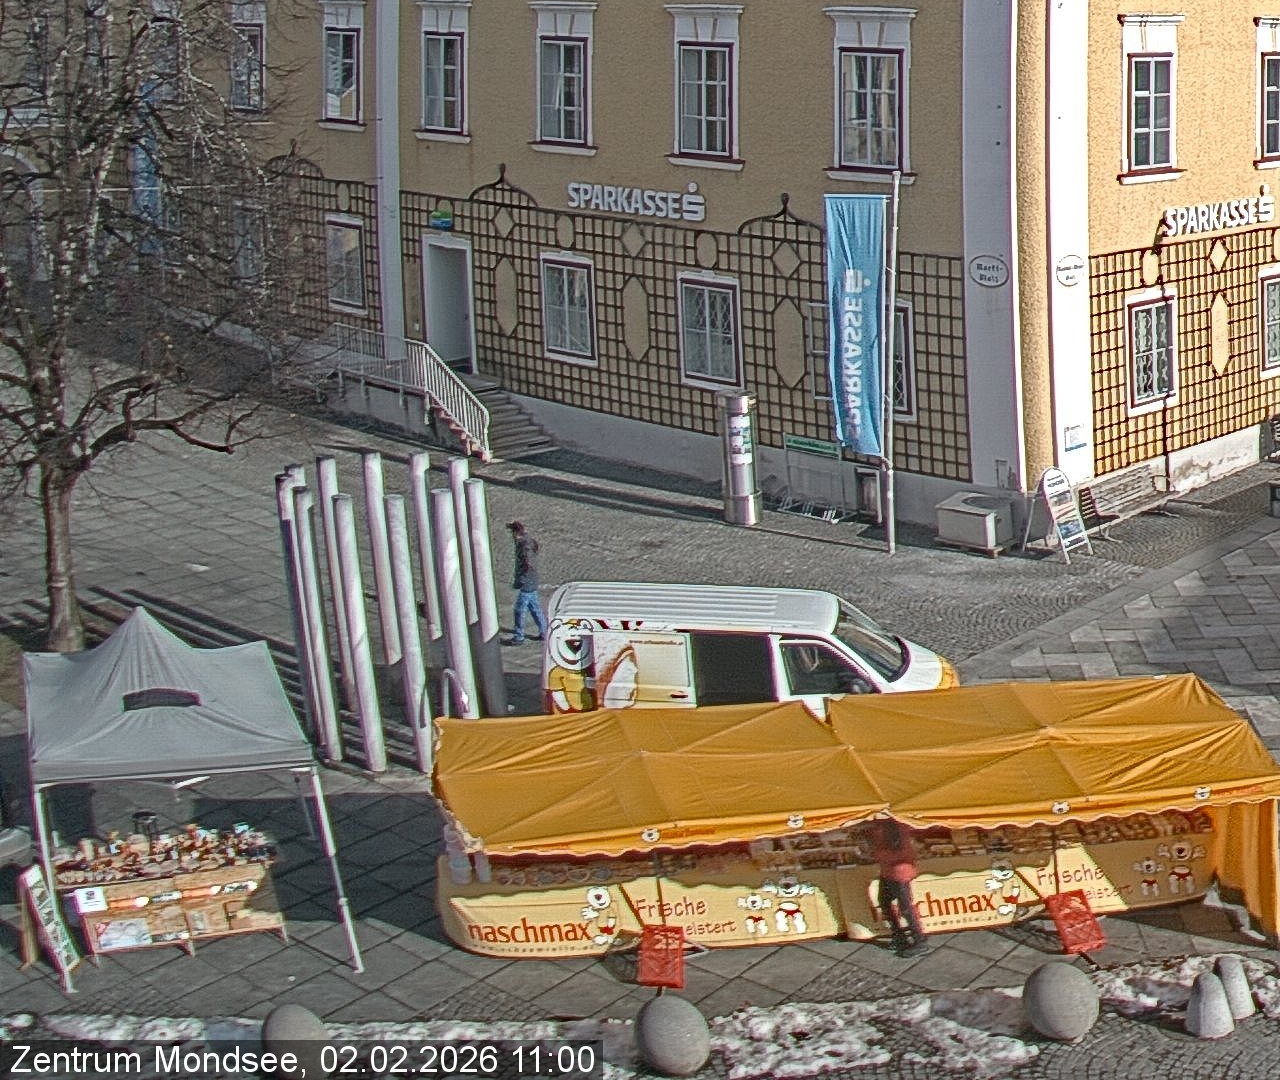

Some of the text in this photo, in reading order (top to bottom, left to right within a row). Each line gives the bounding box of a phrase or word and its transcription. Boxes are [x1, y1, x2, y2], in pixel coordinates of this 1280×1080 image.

[567, 182, 681, 219] SPARKASSE
[1164, 197, 1258, 237] SPARKASSE
[1036, 863, 1103, 886] Frsche
[467, 918, 593, 943] naschmax
